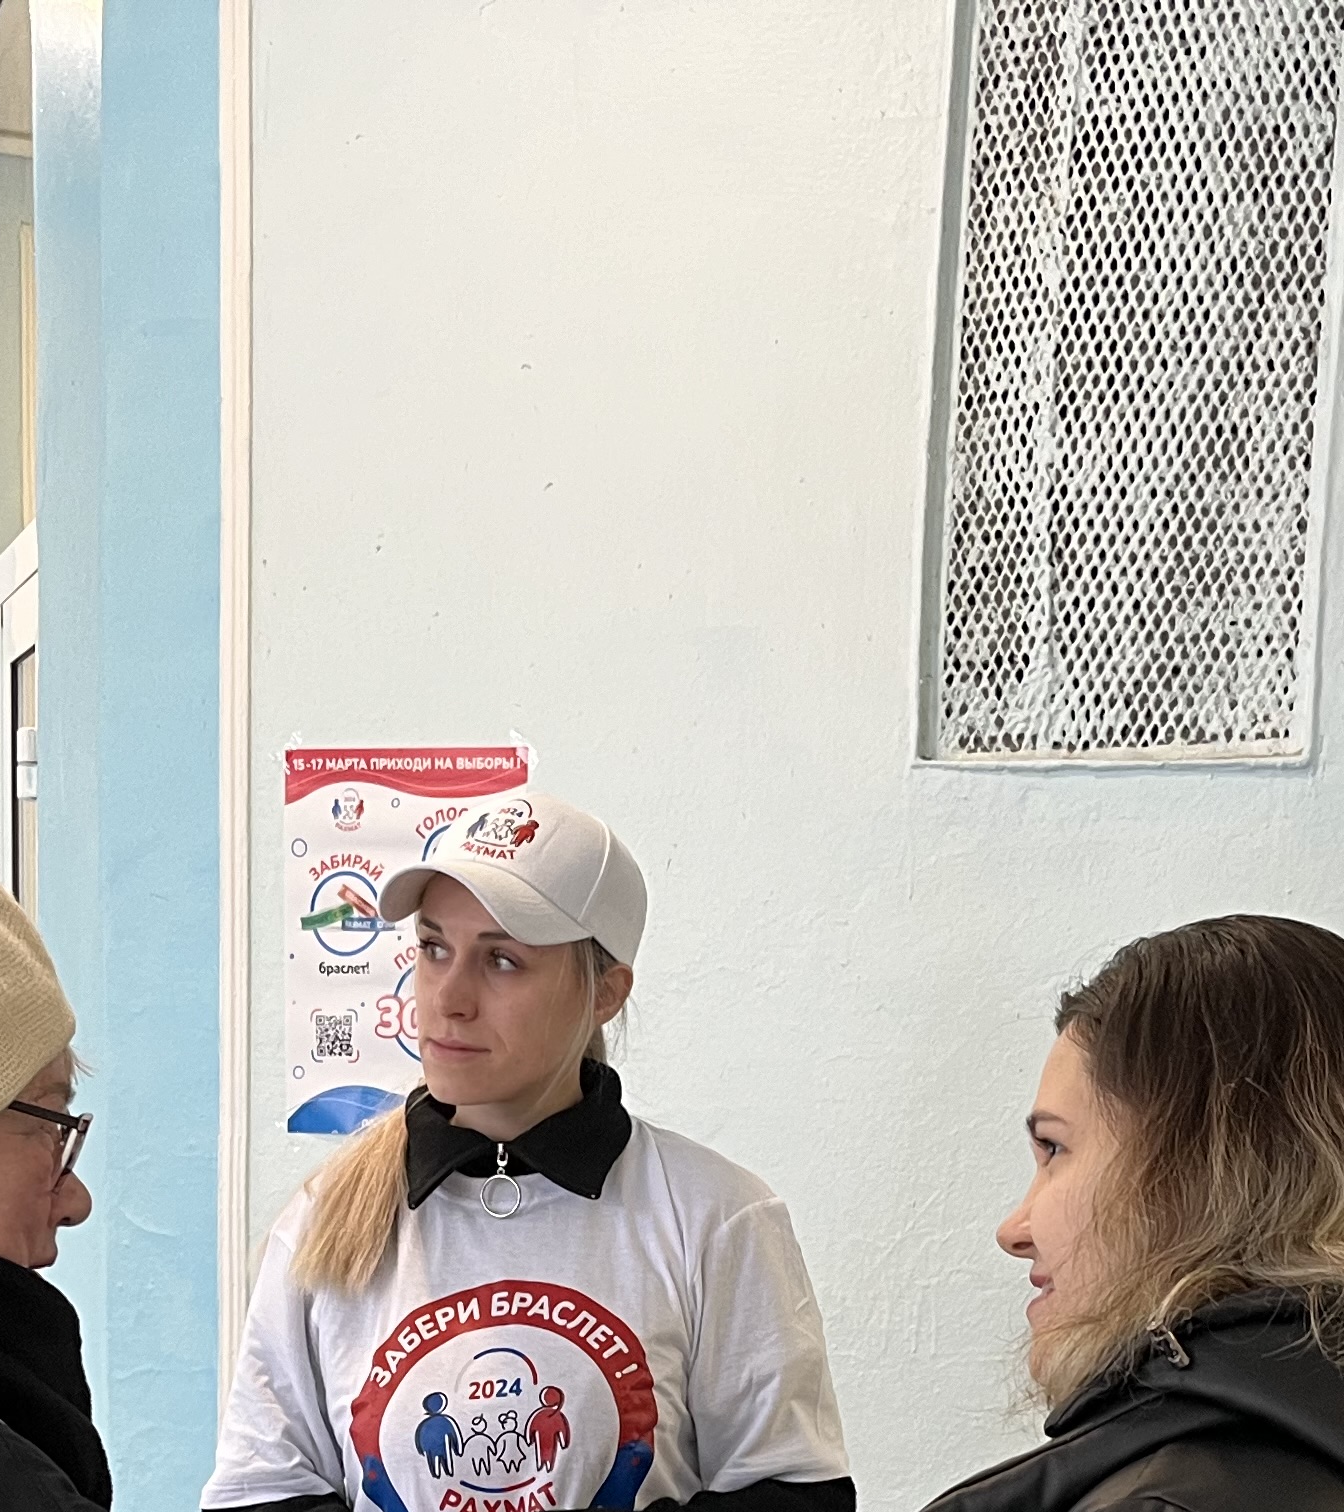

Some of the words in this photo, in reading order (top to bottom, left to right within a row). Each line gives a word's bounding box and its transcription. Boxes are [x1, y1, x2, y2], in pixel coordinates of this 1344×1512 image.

[292, 758, 323, 771] 15-17
[326, 758, 367, 771] МАРТА
[370, 757, 432, 772] ПРИХОДИ
[435, 757, 454, 770] НА
[308, 853, 385, 881] ЗАБИРАЙ
[318, 961, 370, 977] браслет!
[370, 1297, 481, 1388] ЗАБЕРИ
[490, 1291, 630, 1361] БРАСЛЕТ
[468, 1377, 523, 1401] 2024
